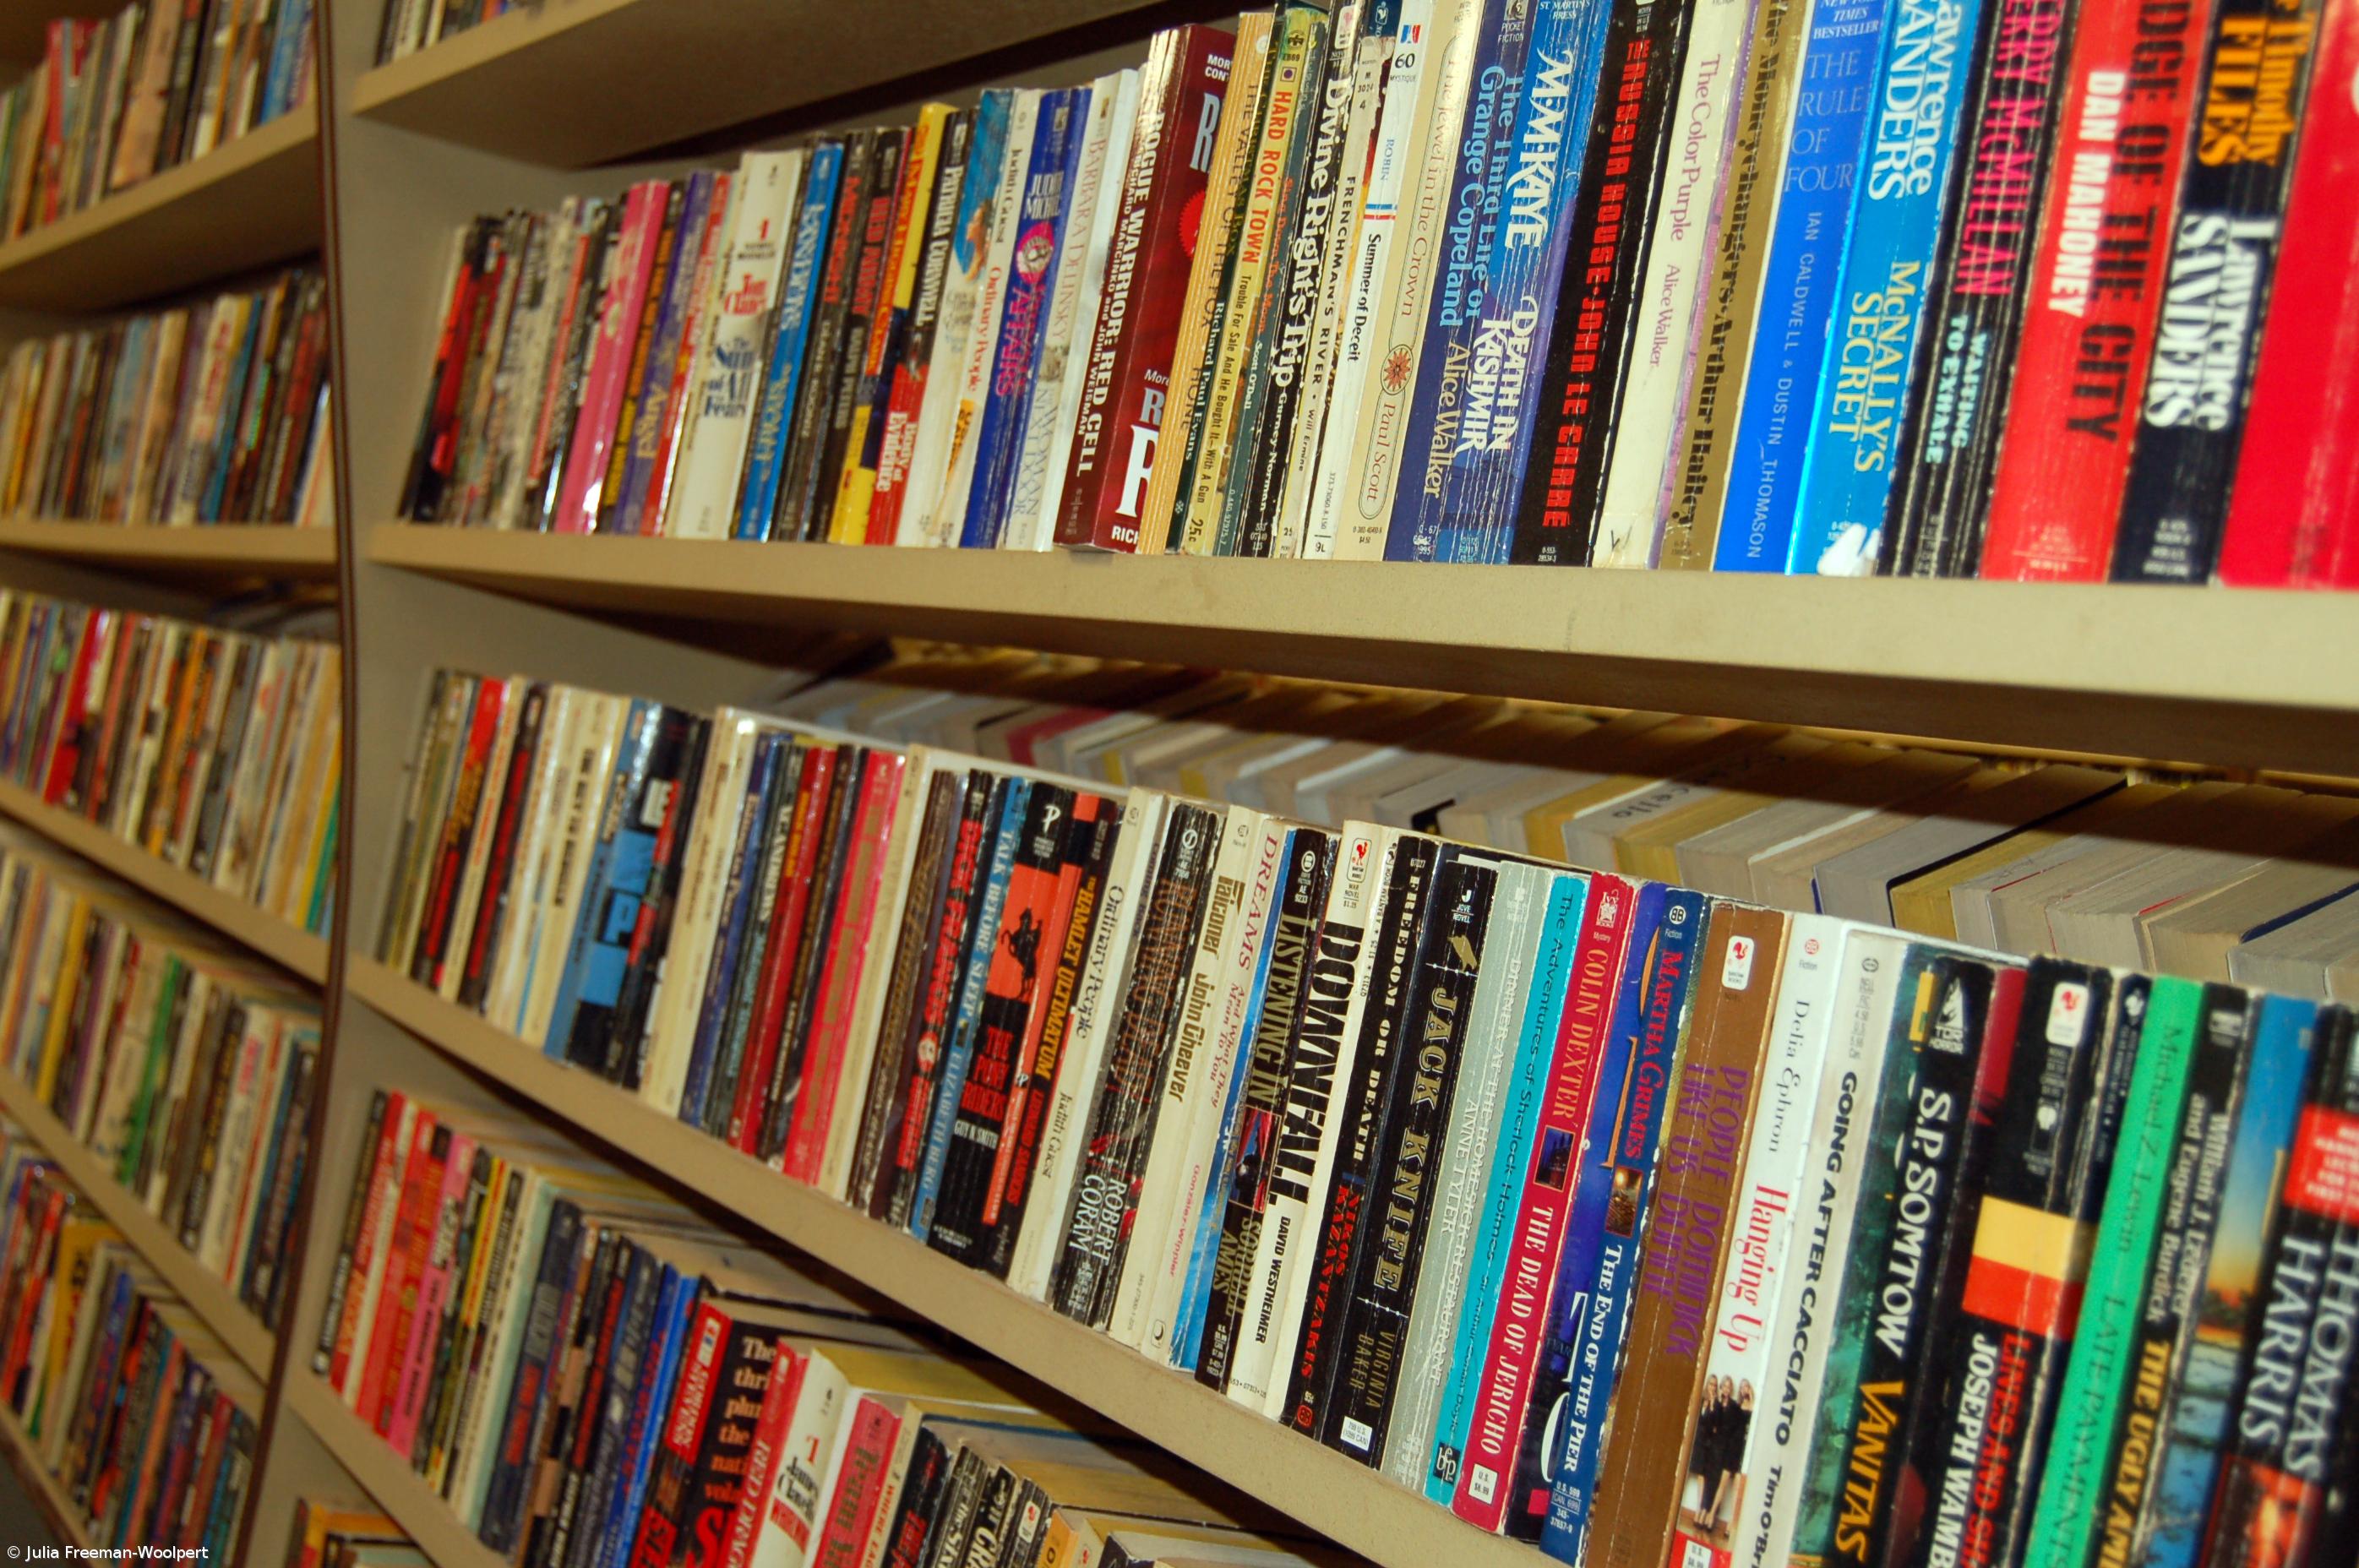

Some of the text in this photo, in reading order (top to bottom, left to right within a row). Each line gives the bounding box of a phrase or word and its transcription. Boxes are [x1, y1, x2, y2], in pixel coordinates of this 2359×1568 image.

[1390, 74, 1418, 82] MYSTIQUE
[1395, 52, 1415, 68] 60
[1806, 50, 1860, 79] THE
[1812, 20, 1880, 41] BESTSELLER
[1906, 0, 1963, 195] awrence
[1380, 138, 1395, 181] ROBIN
[1670, 52, 1722, 242] The Color Purple
[1791, 127, 1831, 155] OF
[1798, 87, 1864, 117] RULE
[1242, 90, 1293, 264] HARD ROCK TOWN
[1270, 78, 1352, 388] Divine Trip
[1324, 175, 1356, 317] FRENCHMAN'S
[1439, 65, 1506, 328] Grange Copeland
[1784, 162, 1853, 193] FOUR
[2046, 70, 2127, 318] DAN MAHONEY
[1076, 112, 1166, 478] ROGUE RED CELL
[1092, 323, 1108, 365] JOHN
[1348, 233, 1381, 362] Summer of Deceit
[1402, 236, 1429, 317] Crown
[1542, 38, 1651, 528] THE RUSSIA HOUSE JOHN LE CARRE
[1648, 306, 1679, 368] Walker
[2065, 205, 2159, 445] THE CITY
[2144, 214, 2229, 427] SANDERS
[1078, 366, 1100, 437] WEISMAN
[1185, 302, 1225, 460] Richard Paul Evans
[1197, 275, 1252, 504] Trouble For Sale And Bought Gun
[1312, 327, 1331, 385] RIVER
[1452, 318, 1512, 459] KASHMIR
[1746, 211, 1822, 558] IAN CALDWELL DUSTIN THOMASON
[1828, 291, 1883, 443] SECRET
[1925, 313, 1969, 464] TO EXHALE
[1950, 333, 1988, 449] WAITING
[1366, 401, 1396, 502] Paul Scott
[1423, 409, 1462, 499] Walker
[1238, 833, 1279, 972] DREAMS
[1384, 874, 1421, 1007] FREEDOM
[1664, 928, 1682, 939] Fiction
[1798, 960, 1818, 971] Fiction
[1494, 957, 1522, 1042] DINNER
[1551, 948, 1610, 1119] COLIN DEXTER
[1623, 947, 1684, 1160] MARTHA GRIMES
[1352, 1069, 1381, 1162] DEATH
[1373, 986, 1458, 1293] JACK KNIFE
[1486, 893, 1575, 1261] The Adventures of Sherlock Holmes
[1769, 998, 1811, 1153] Delia Ephron
[1068, 1173, 1108, 1254] CORAM
[1092, 1178, 1128, 1266] ROBERT
[1441, 1097, 1480, 1234] ANNE TYLER
[1458, 1124, 1490, 1244] HOMESICK
[2145, 1141, 2200, 1324] Eugene Burdick
[1212, 1228, 1239, 1294] AMES
[1255, 1215, 1292, 1345] DAVID WESTHEIMER
[1429, 1244, 1468, 1387] RESTAURANT
[1719, 1183, 1790, 1353] Hanging Up
[1768, 1070, 1858, 1505] GOING AFTER CACCIATO Tim
[1874, 1159, 1938, 1360] SOMTOW
[1348, 1333, 1375, 1391] BAKER
[1365, 1330, 1396, 1409] VIRGINIA
[1479, 1205, 1555, 1456] THE DEAD OF JERICHO
[1564, 1243, 1623, 1473] THE END OF THE PIER
[1951, 1331, 1997, 1463] JOSEPH
[2239, 1234, 2324, 1446] HARRIS
[1833, 1380, 1904, 1562] VANITAS
[1974, 1331, 2033, 1512] LINES AND
[2114, 1339, 2173, 1507] THE UGLY
